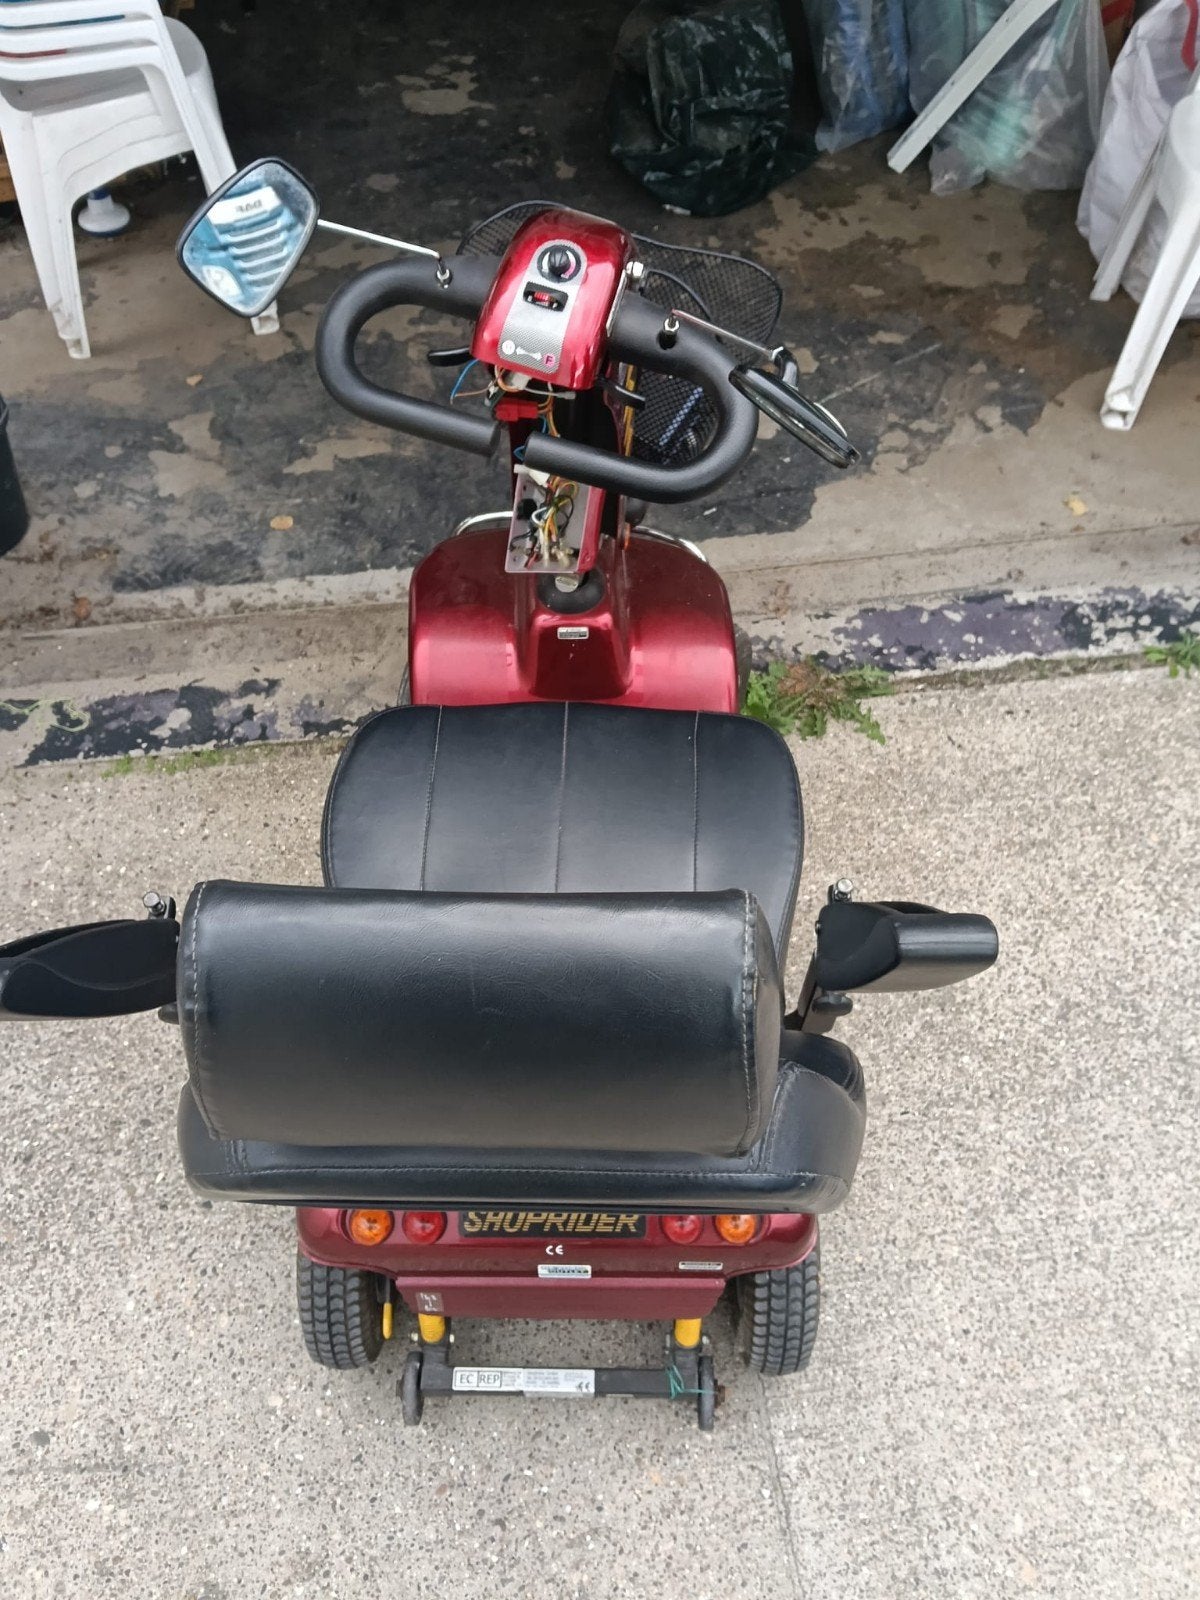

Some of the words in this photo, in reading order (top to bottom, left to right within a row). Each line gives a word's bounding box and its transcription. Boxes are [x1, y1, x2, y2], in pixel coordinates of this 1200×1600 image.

[545, 355, 553, 365] F
[463, 1211, 640, 1233] SHOPRIDER
[545, 1244, 564, 1256] CE
[459, 1373, 474, 1384] EC
[479, 1374, 500, 1385] REP
